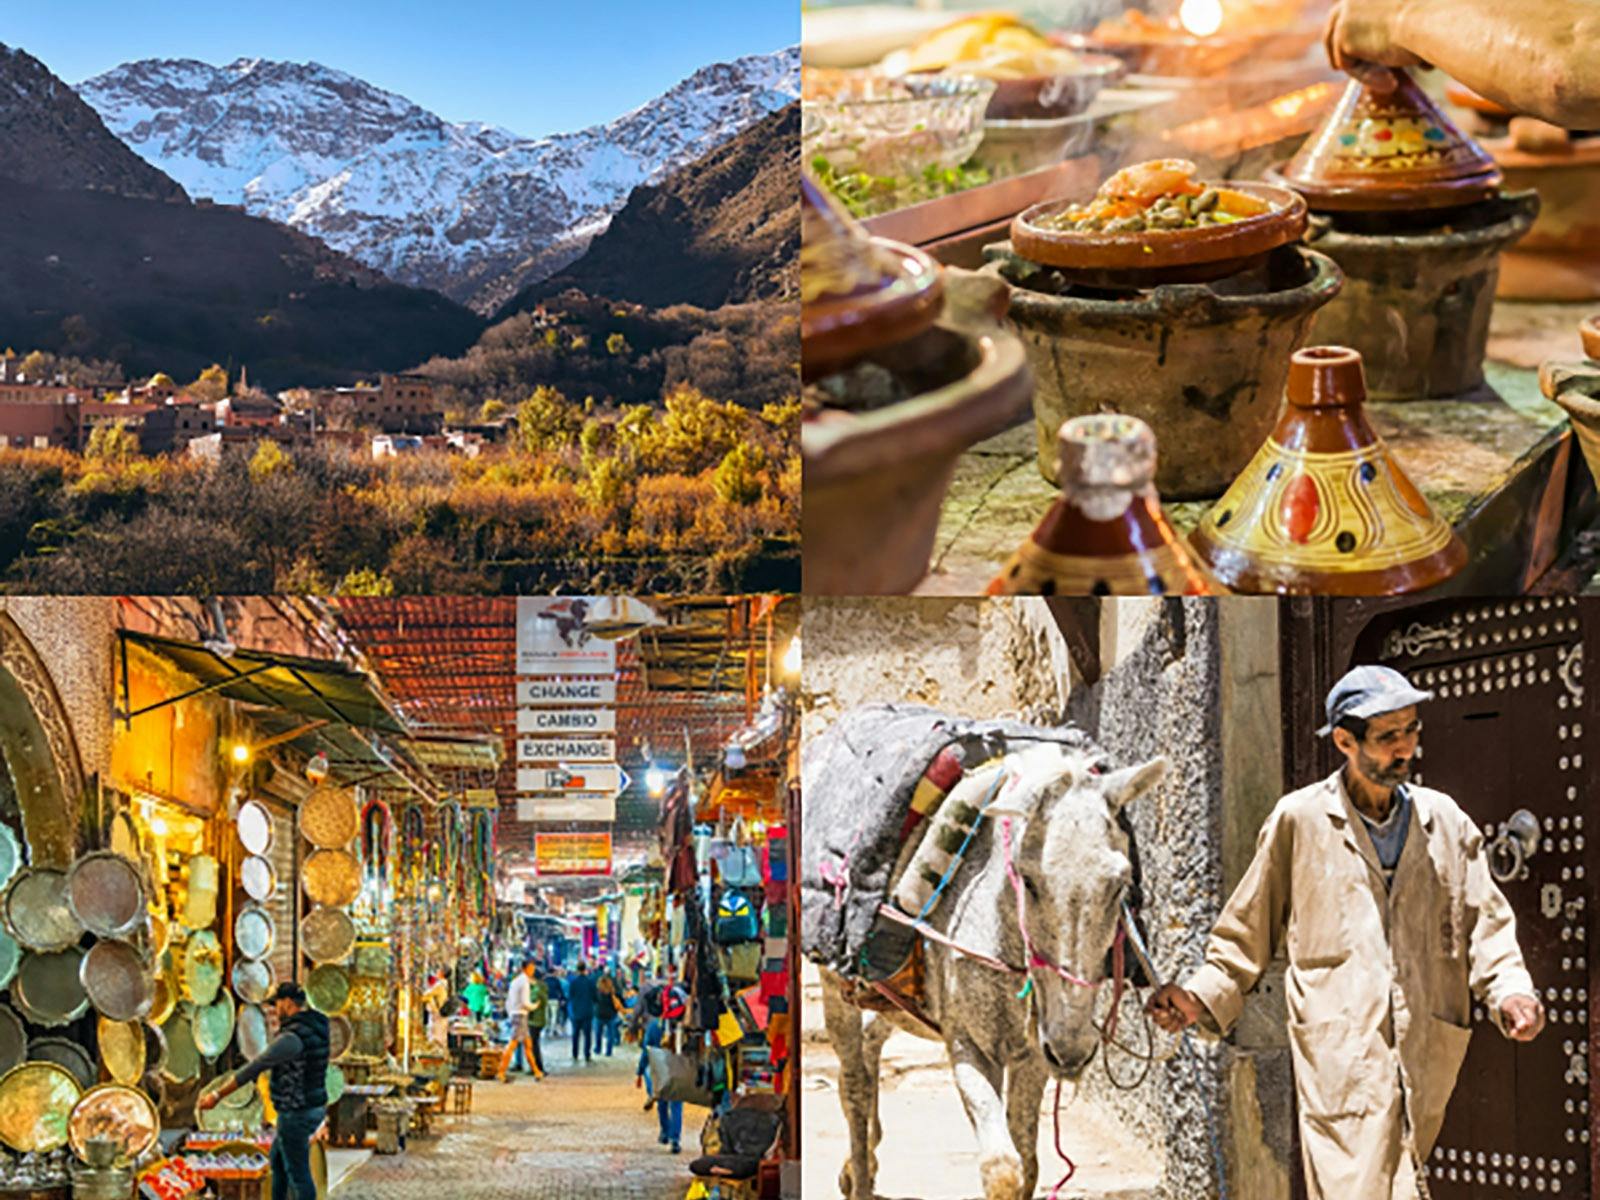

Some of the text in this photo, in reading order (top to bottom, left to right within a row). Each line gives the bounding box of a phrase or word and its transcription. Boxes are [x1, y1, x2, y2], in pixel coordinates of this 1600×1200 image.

[529, 685, 601, 698] CHANGE
[537, 714, 597, 727] CAMBIO
[523, 743, 610, 757] EXCHANGE
